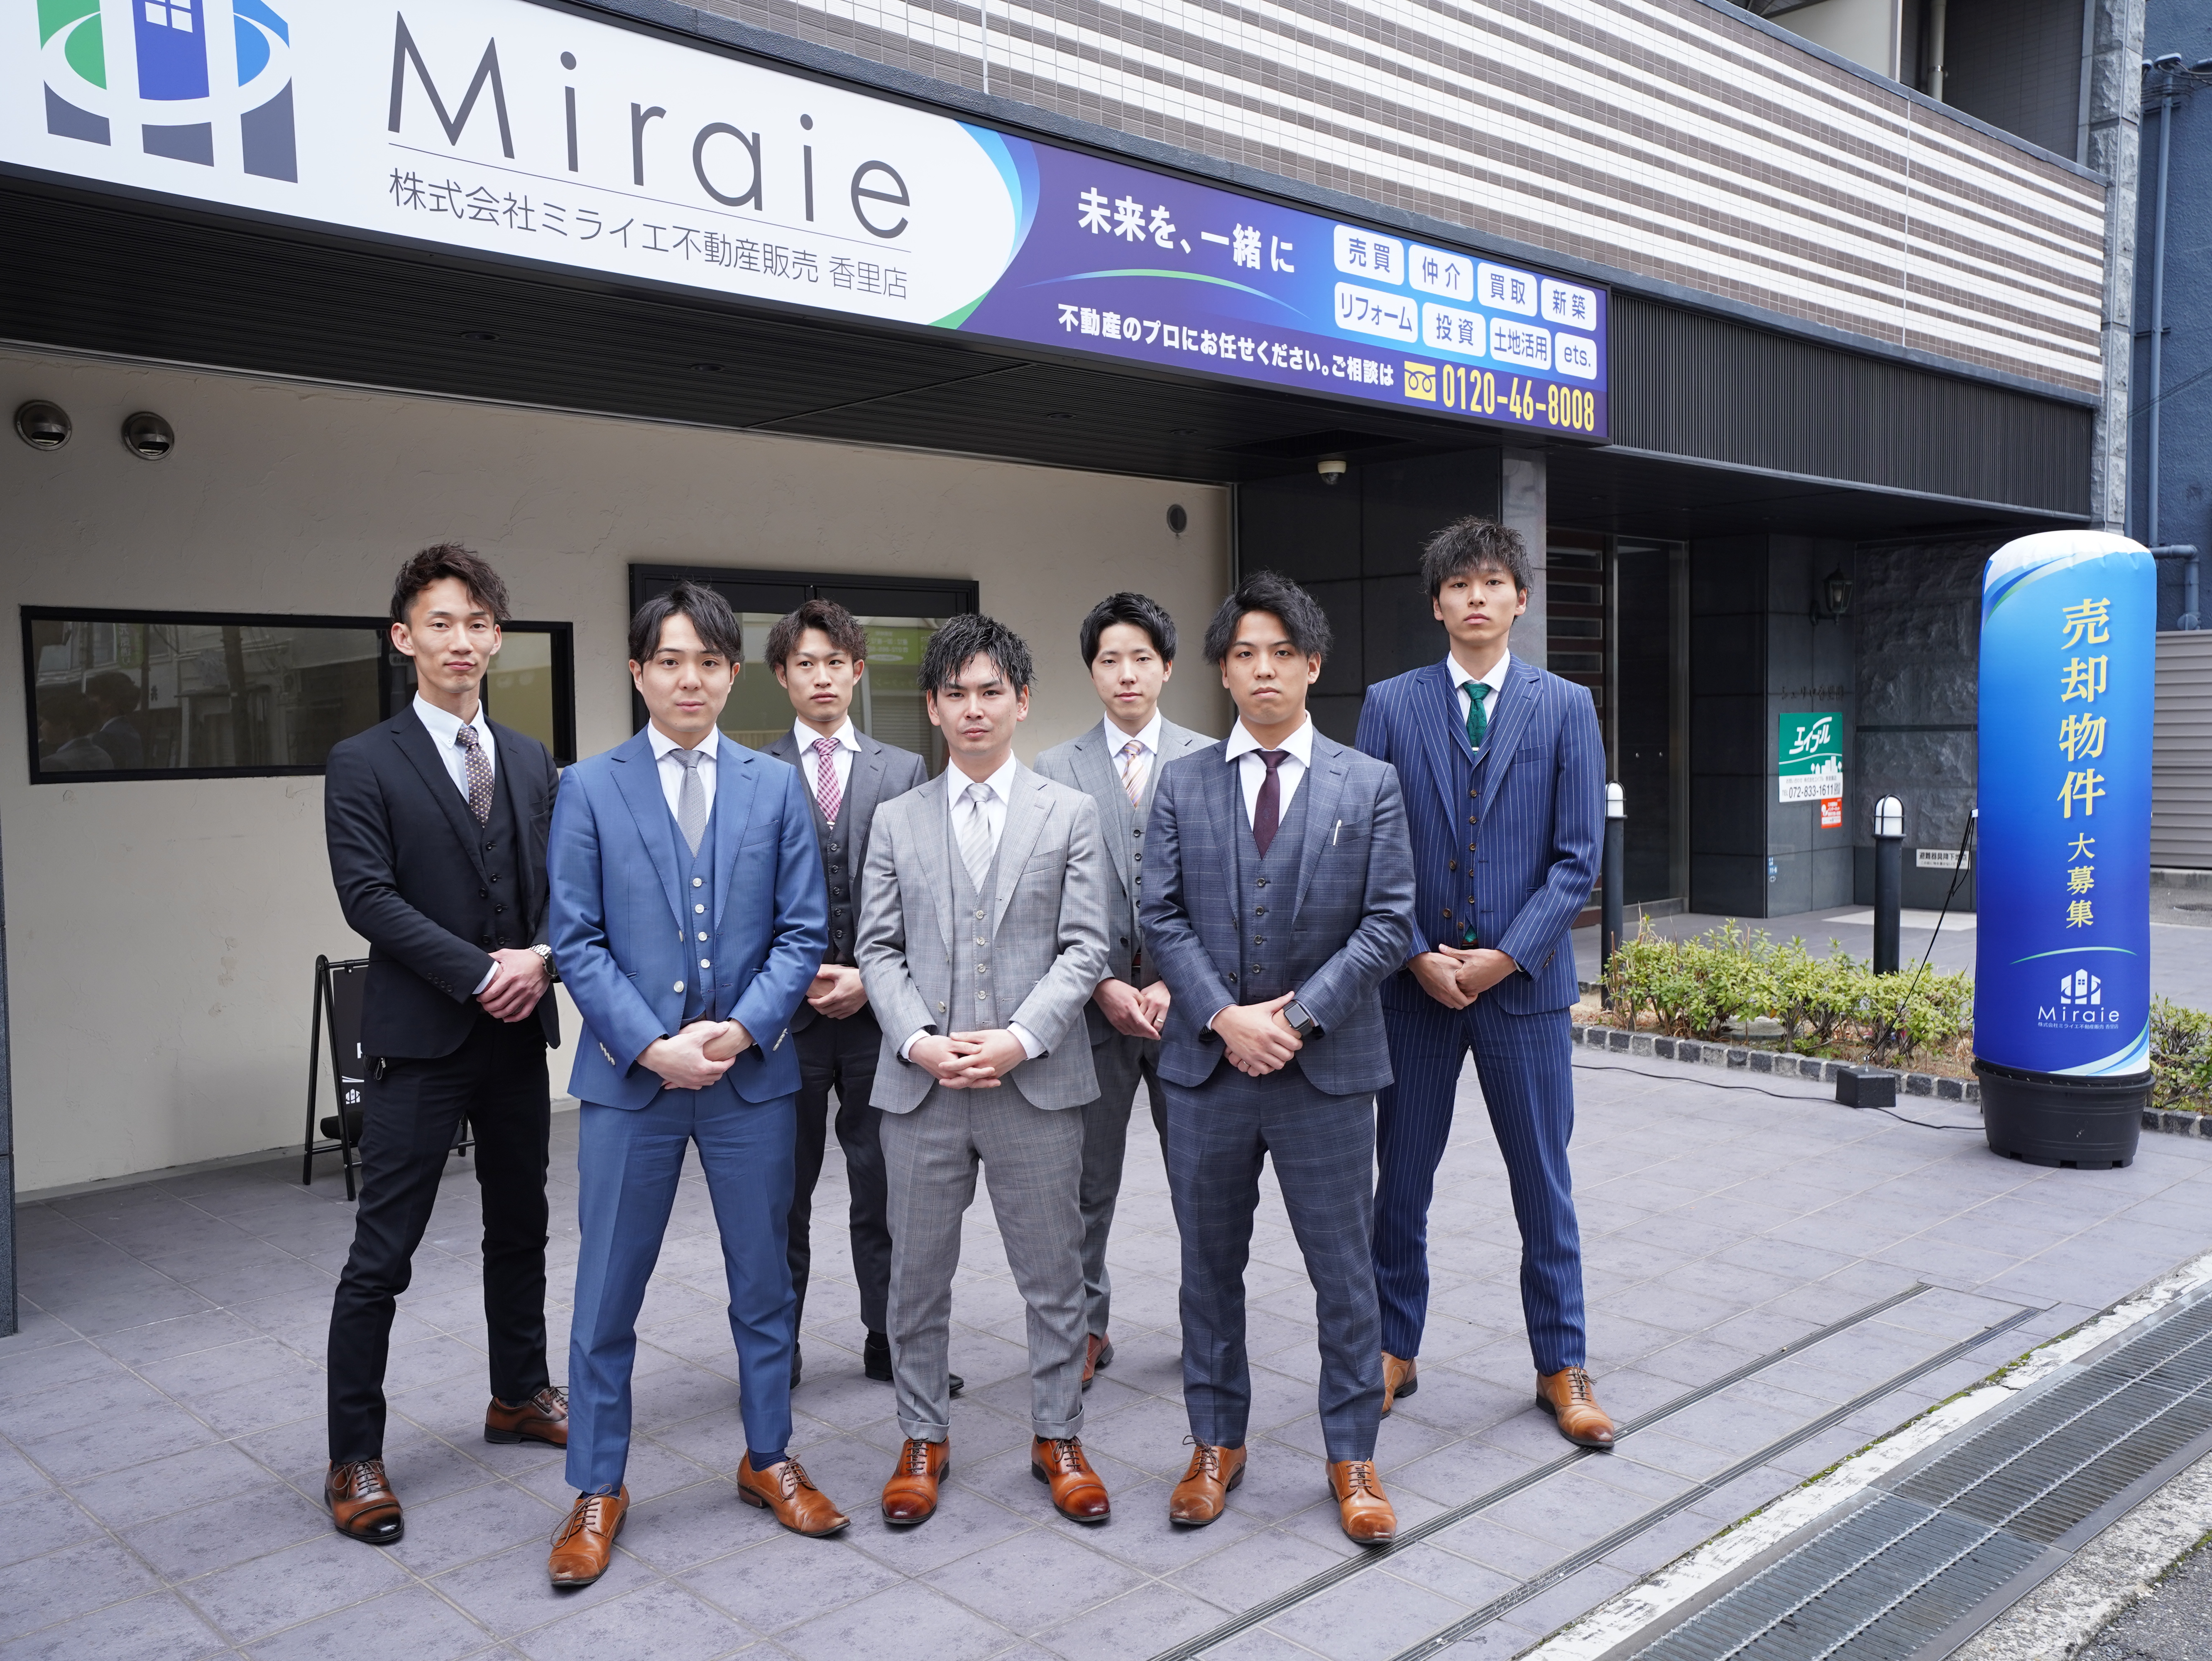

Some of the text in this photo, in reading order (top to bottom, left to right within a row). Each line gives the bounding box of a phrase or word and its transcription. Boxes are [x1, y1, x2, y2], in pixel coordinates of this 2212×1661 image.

[388, 10, 910, 239] Miraie
[389, 167, 907, 299] 株式会社ミライエ不動産販売 香里店
[1078, 187, 1294, 273] 未来を、一緒に
[1348, 238, 1390, 273] 売買
[1422, 256, 1460, 291] 仲介
[1490, 273, 1525, 306] 買取
[1341, 292, 1412, 332] リフォーム
[1552, 289, 1586, 320] 新築
[1058, 303, 1394, 386] 不動産のプロにお任せください。ご相談は
[1436, 313, 1474, 346] 投資
[1494, 326, 1547, 361] 土地活用
[1564, 348, 1591, 367] ets.
[1442, 364, 1595, 431] 0120-46-8008
[1789, 716, 1832, 755] エイブル
[2057, 597, 2111, 928] 売却物件 大募集
[1789, 784, 1833, 798] 072-833-1611
[2038, 1005, 2119, 1022] Miraie
